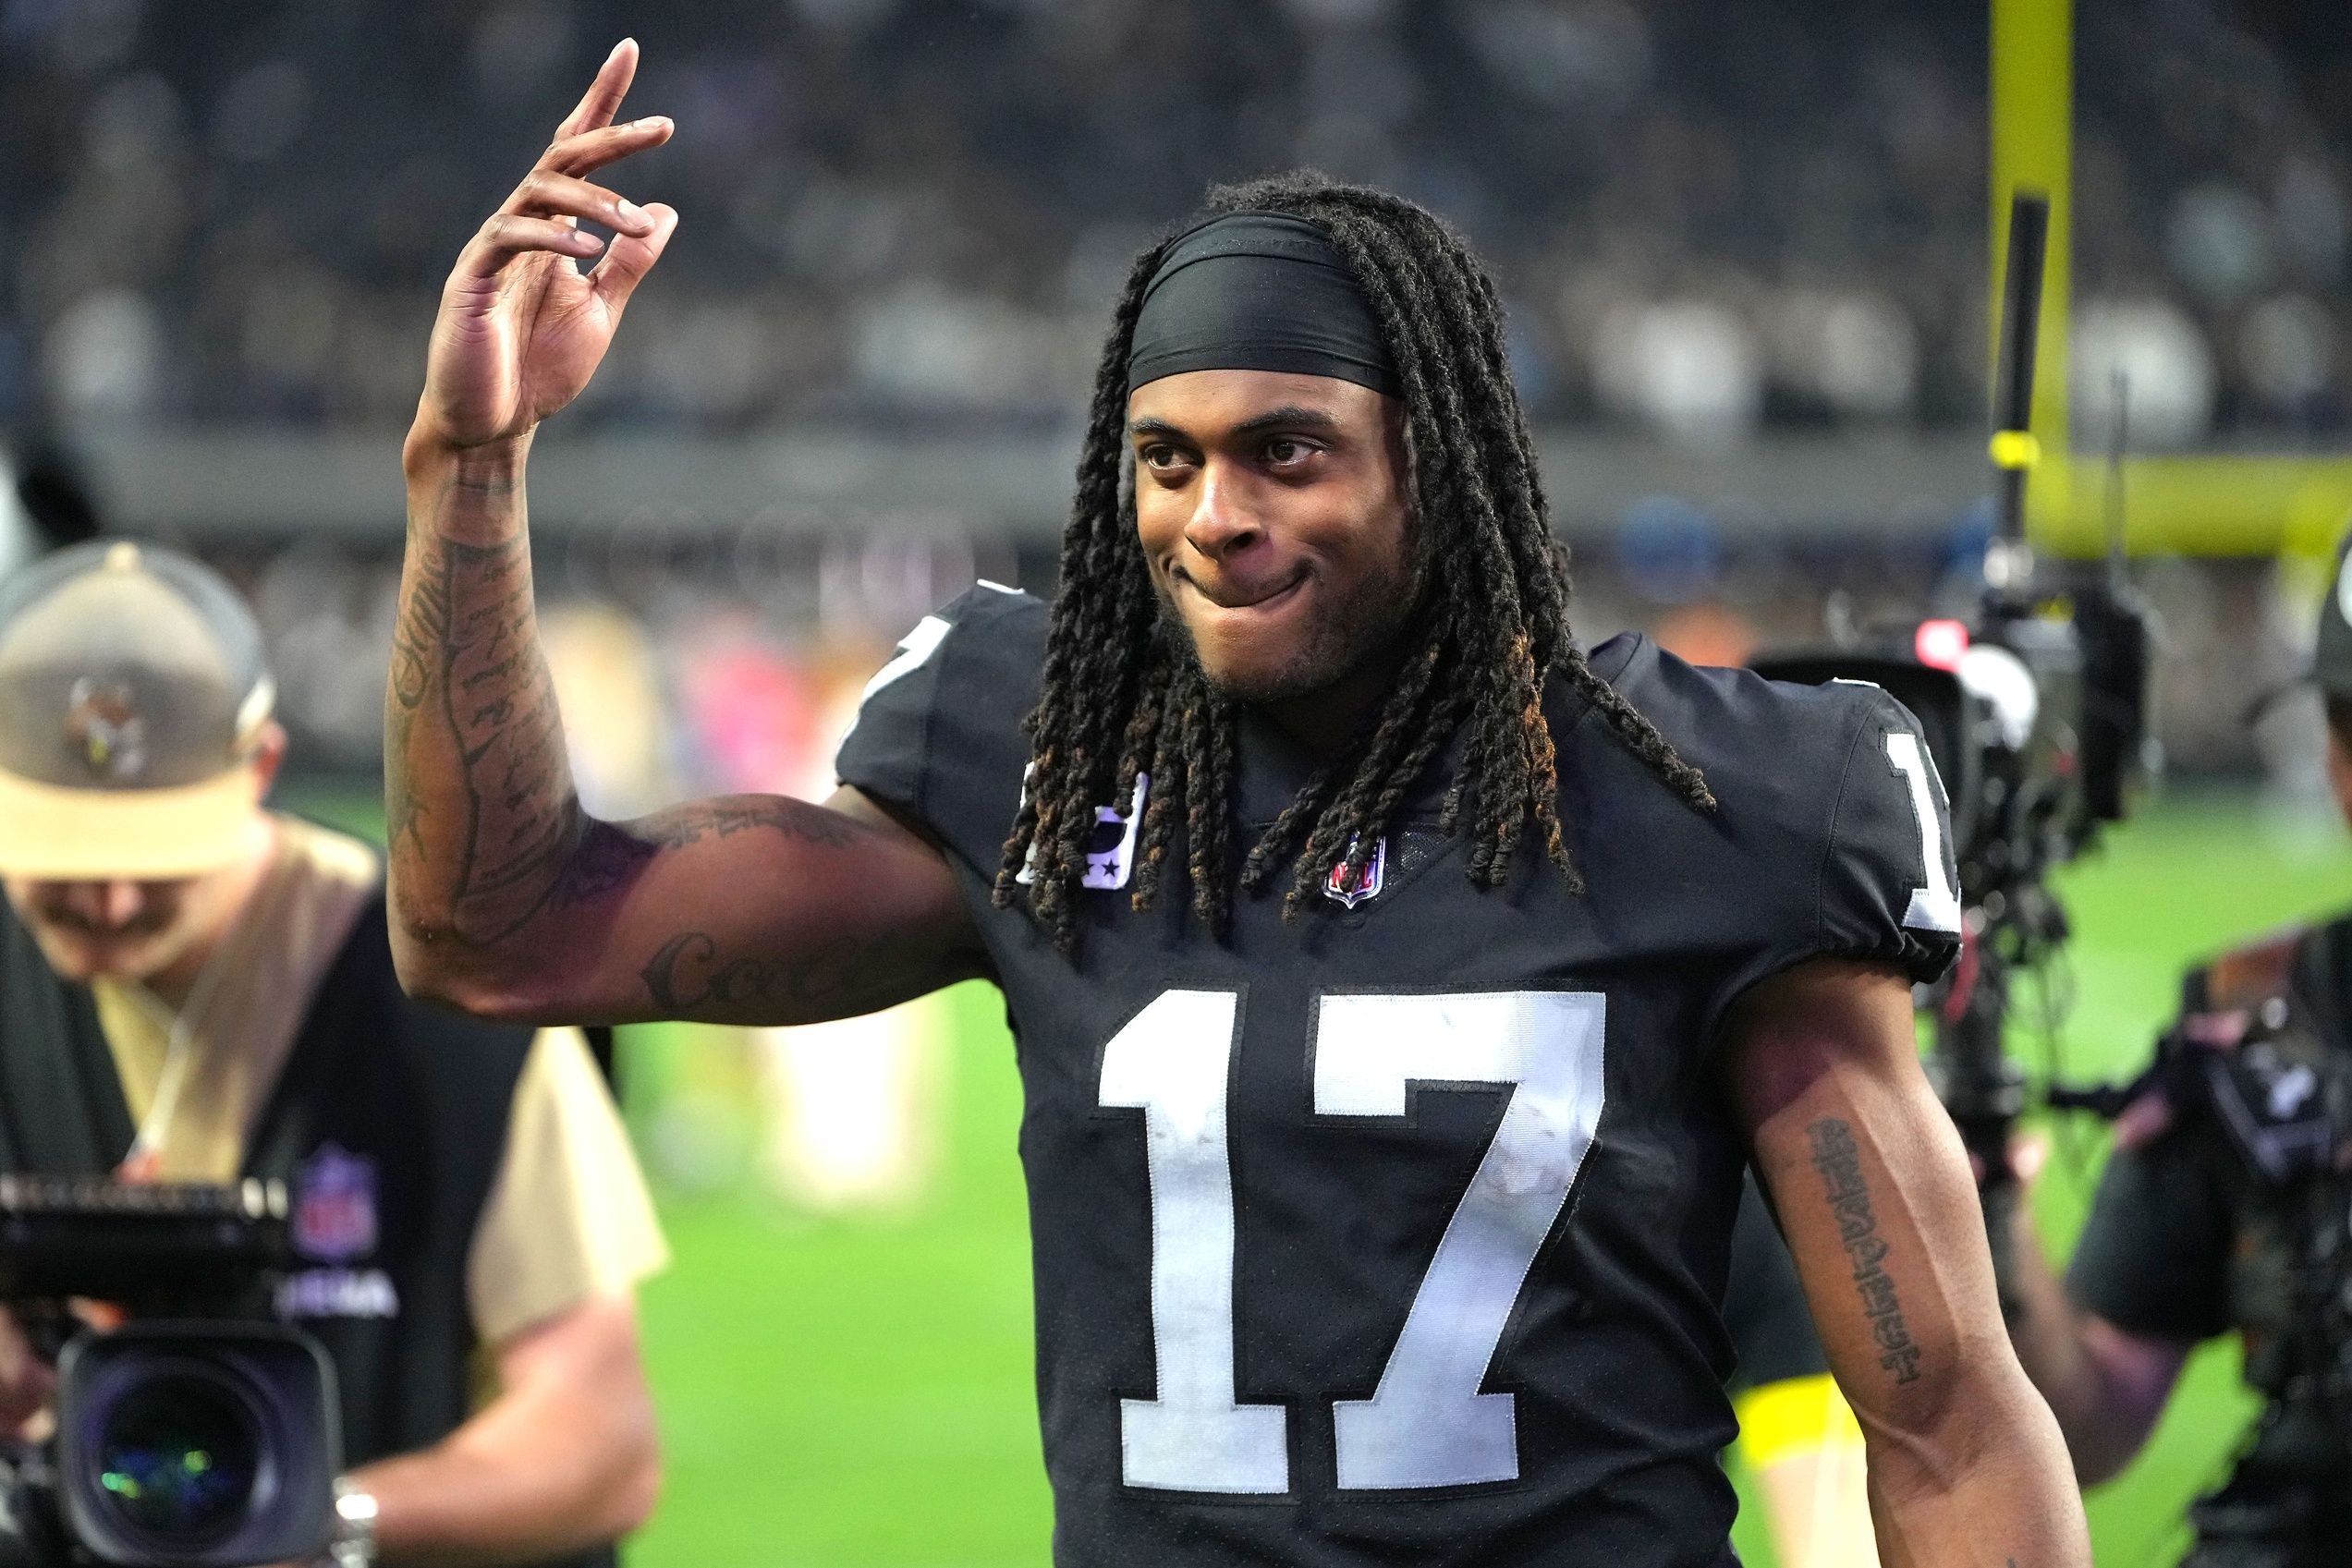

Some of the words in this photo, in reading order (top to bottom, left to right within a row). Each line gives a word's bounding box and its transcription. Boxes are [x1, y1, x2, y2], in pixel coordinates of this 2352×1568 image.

[1328, 860, 1373, 889] NL
[1887, 733, 1962, 932] 1
[1098, 989, 1606, 1494] 17
